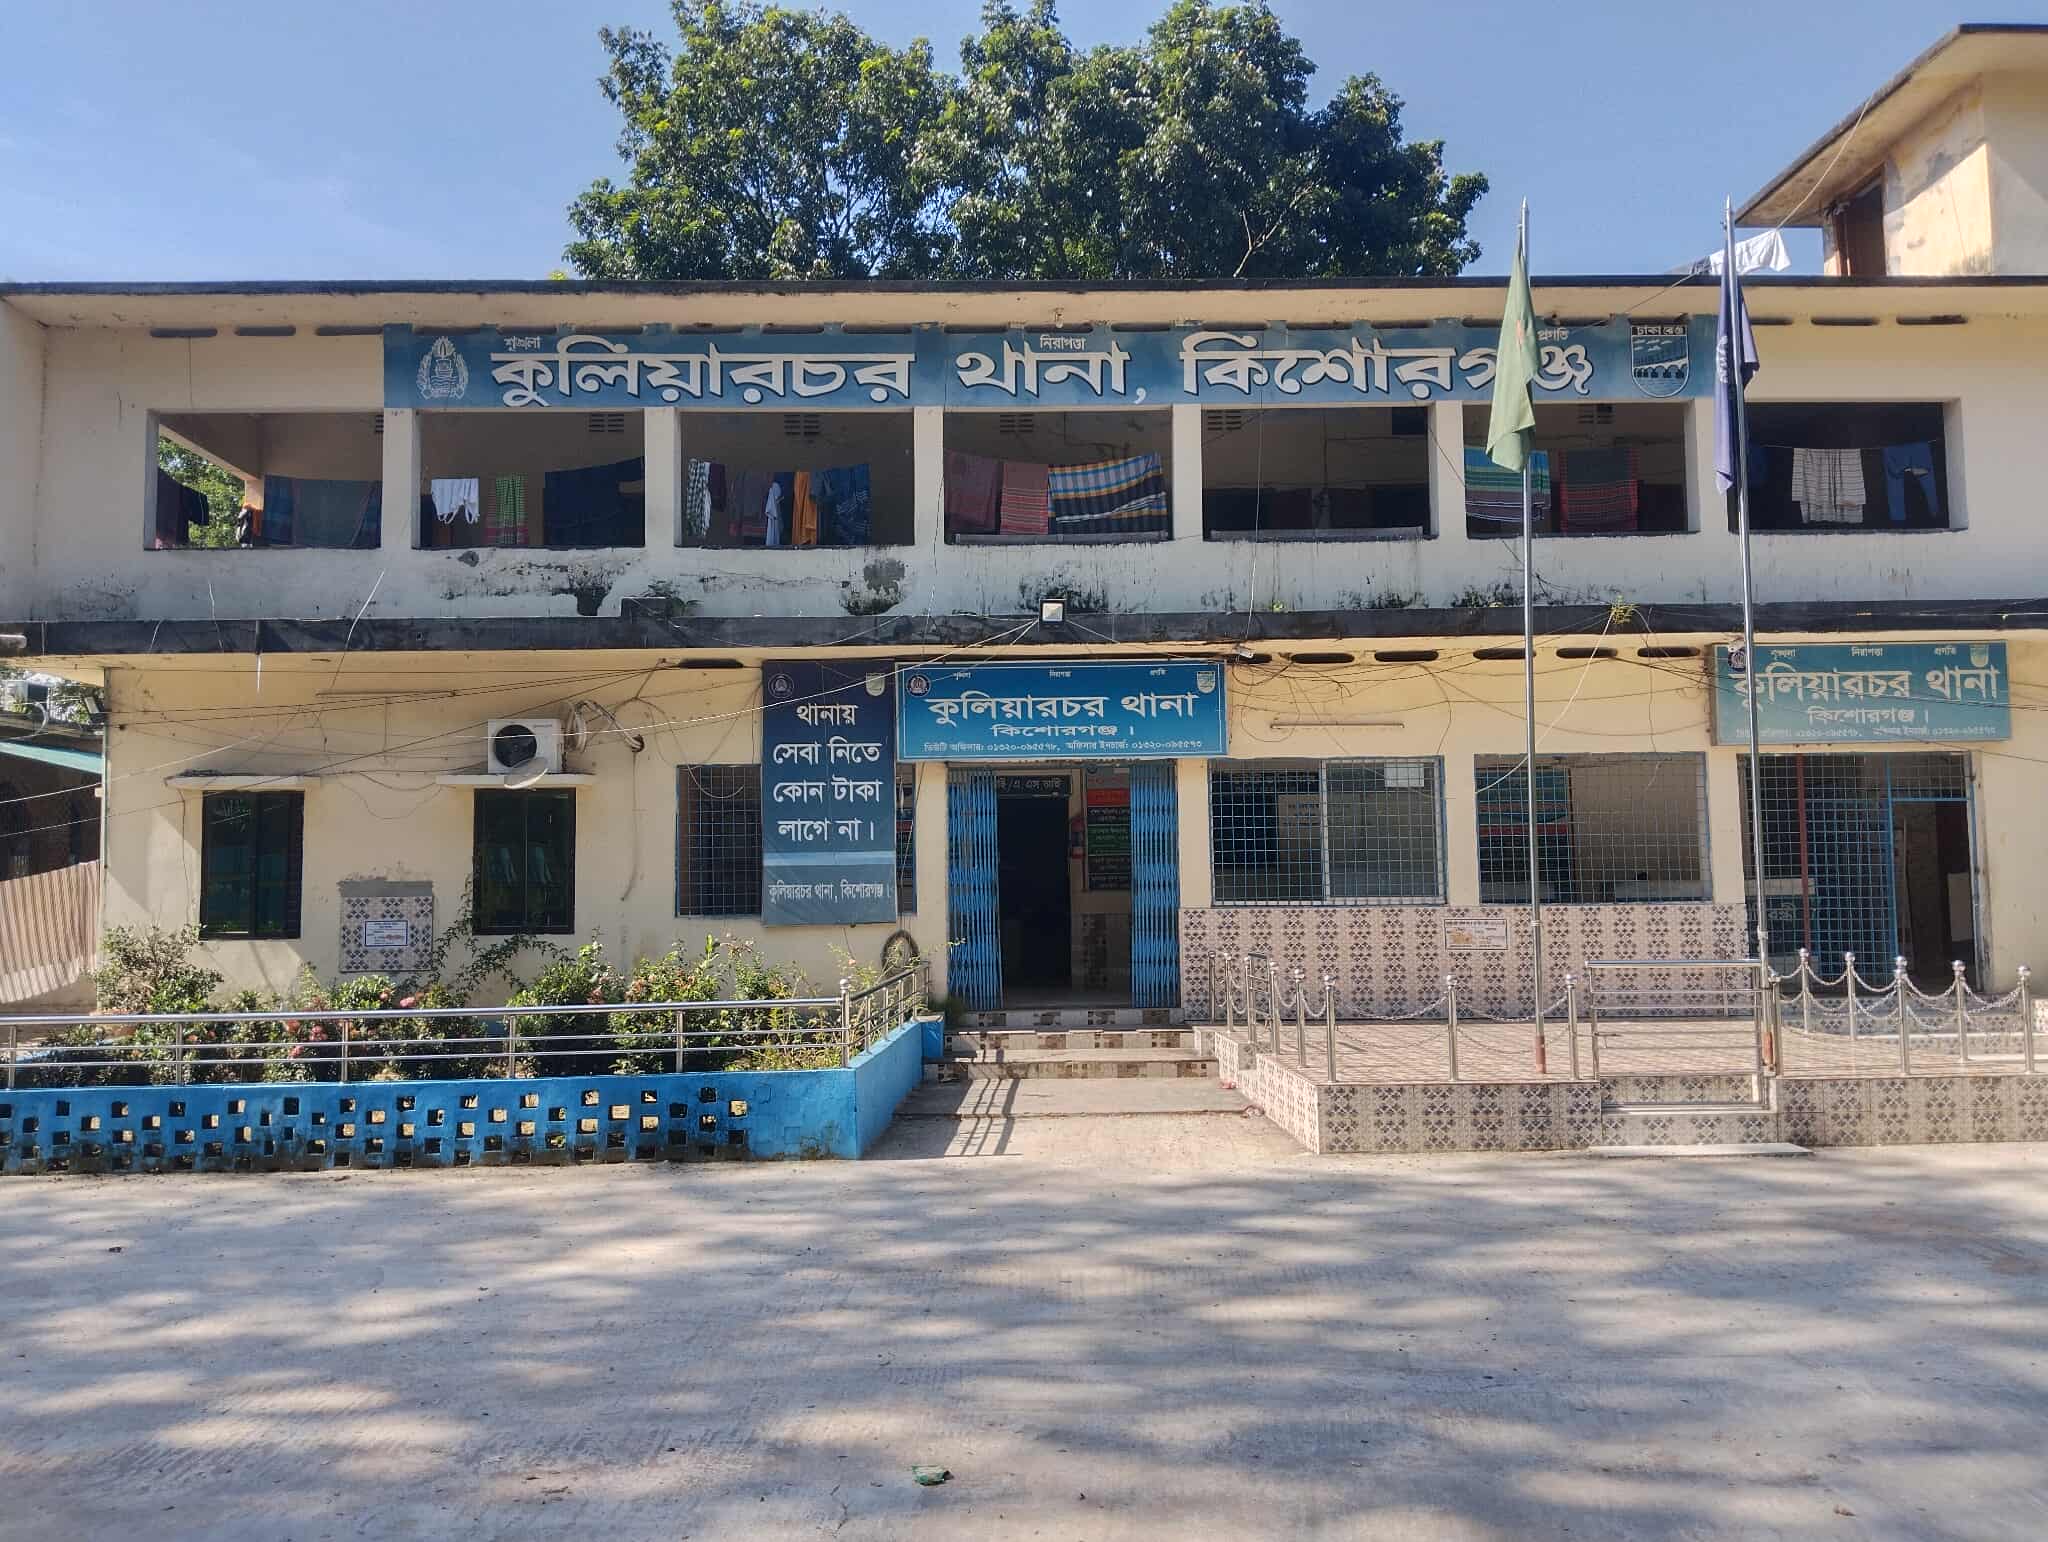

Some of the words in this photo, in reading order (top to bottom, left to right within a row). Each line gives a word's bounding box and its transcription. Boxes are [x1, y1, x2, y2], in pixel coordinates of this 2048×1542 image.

[490, 335, 916, 408] কুলিয়ারচর
[955, 340, 1148, 405] থানা,
[1925, 663, 2001, 701] থানা
[796, 702, 859, 727] থানায়
[924, 689, 1110, 728] কুলিয়ারচর
[1121, 690, 1200, 719] থানা
[989, 722, 1119, 738] কিশোরগঞ্জ
[772, 741, 823, 766] সেবা
[827, 734, 883, 766] নিতে
[772, 779, 827, 805] কোন
[830, 773, 884, 803] টাকা
[777, 818, 831, 842] লাগে
[768, 880, 813, 904] কুলিয়ারচর
